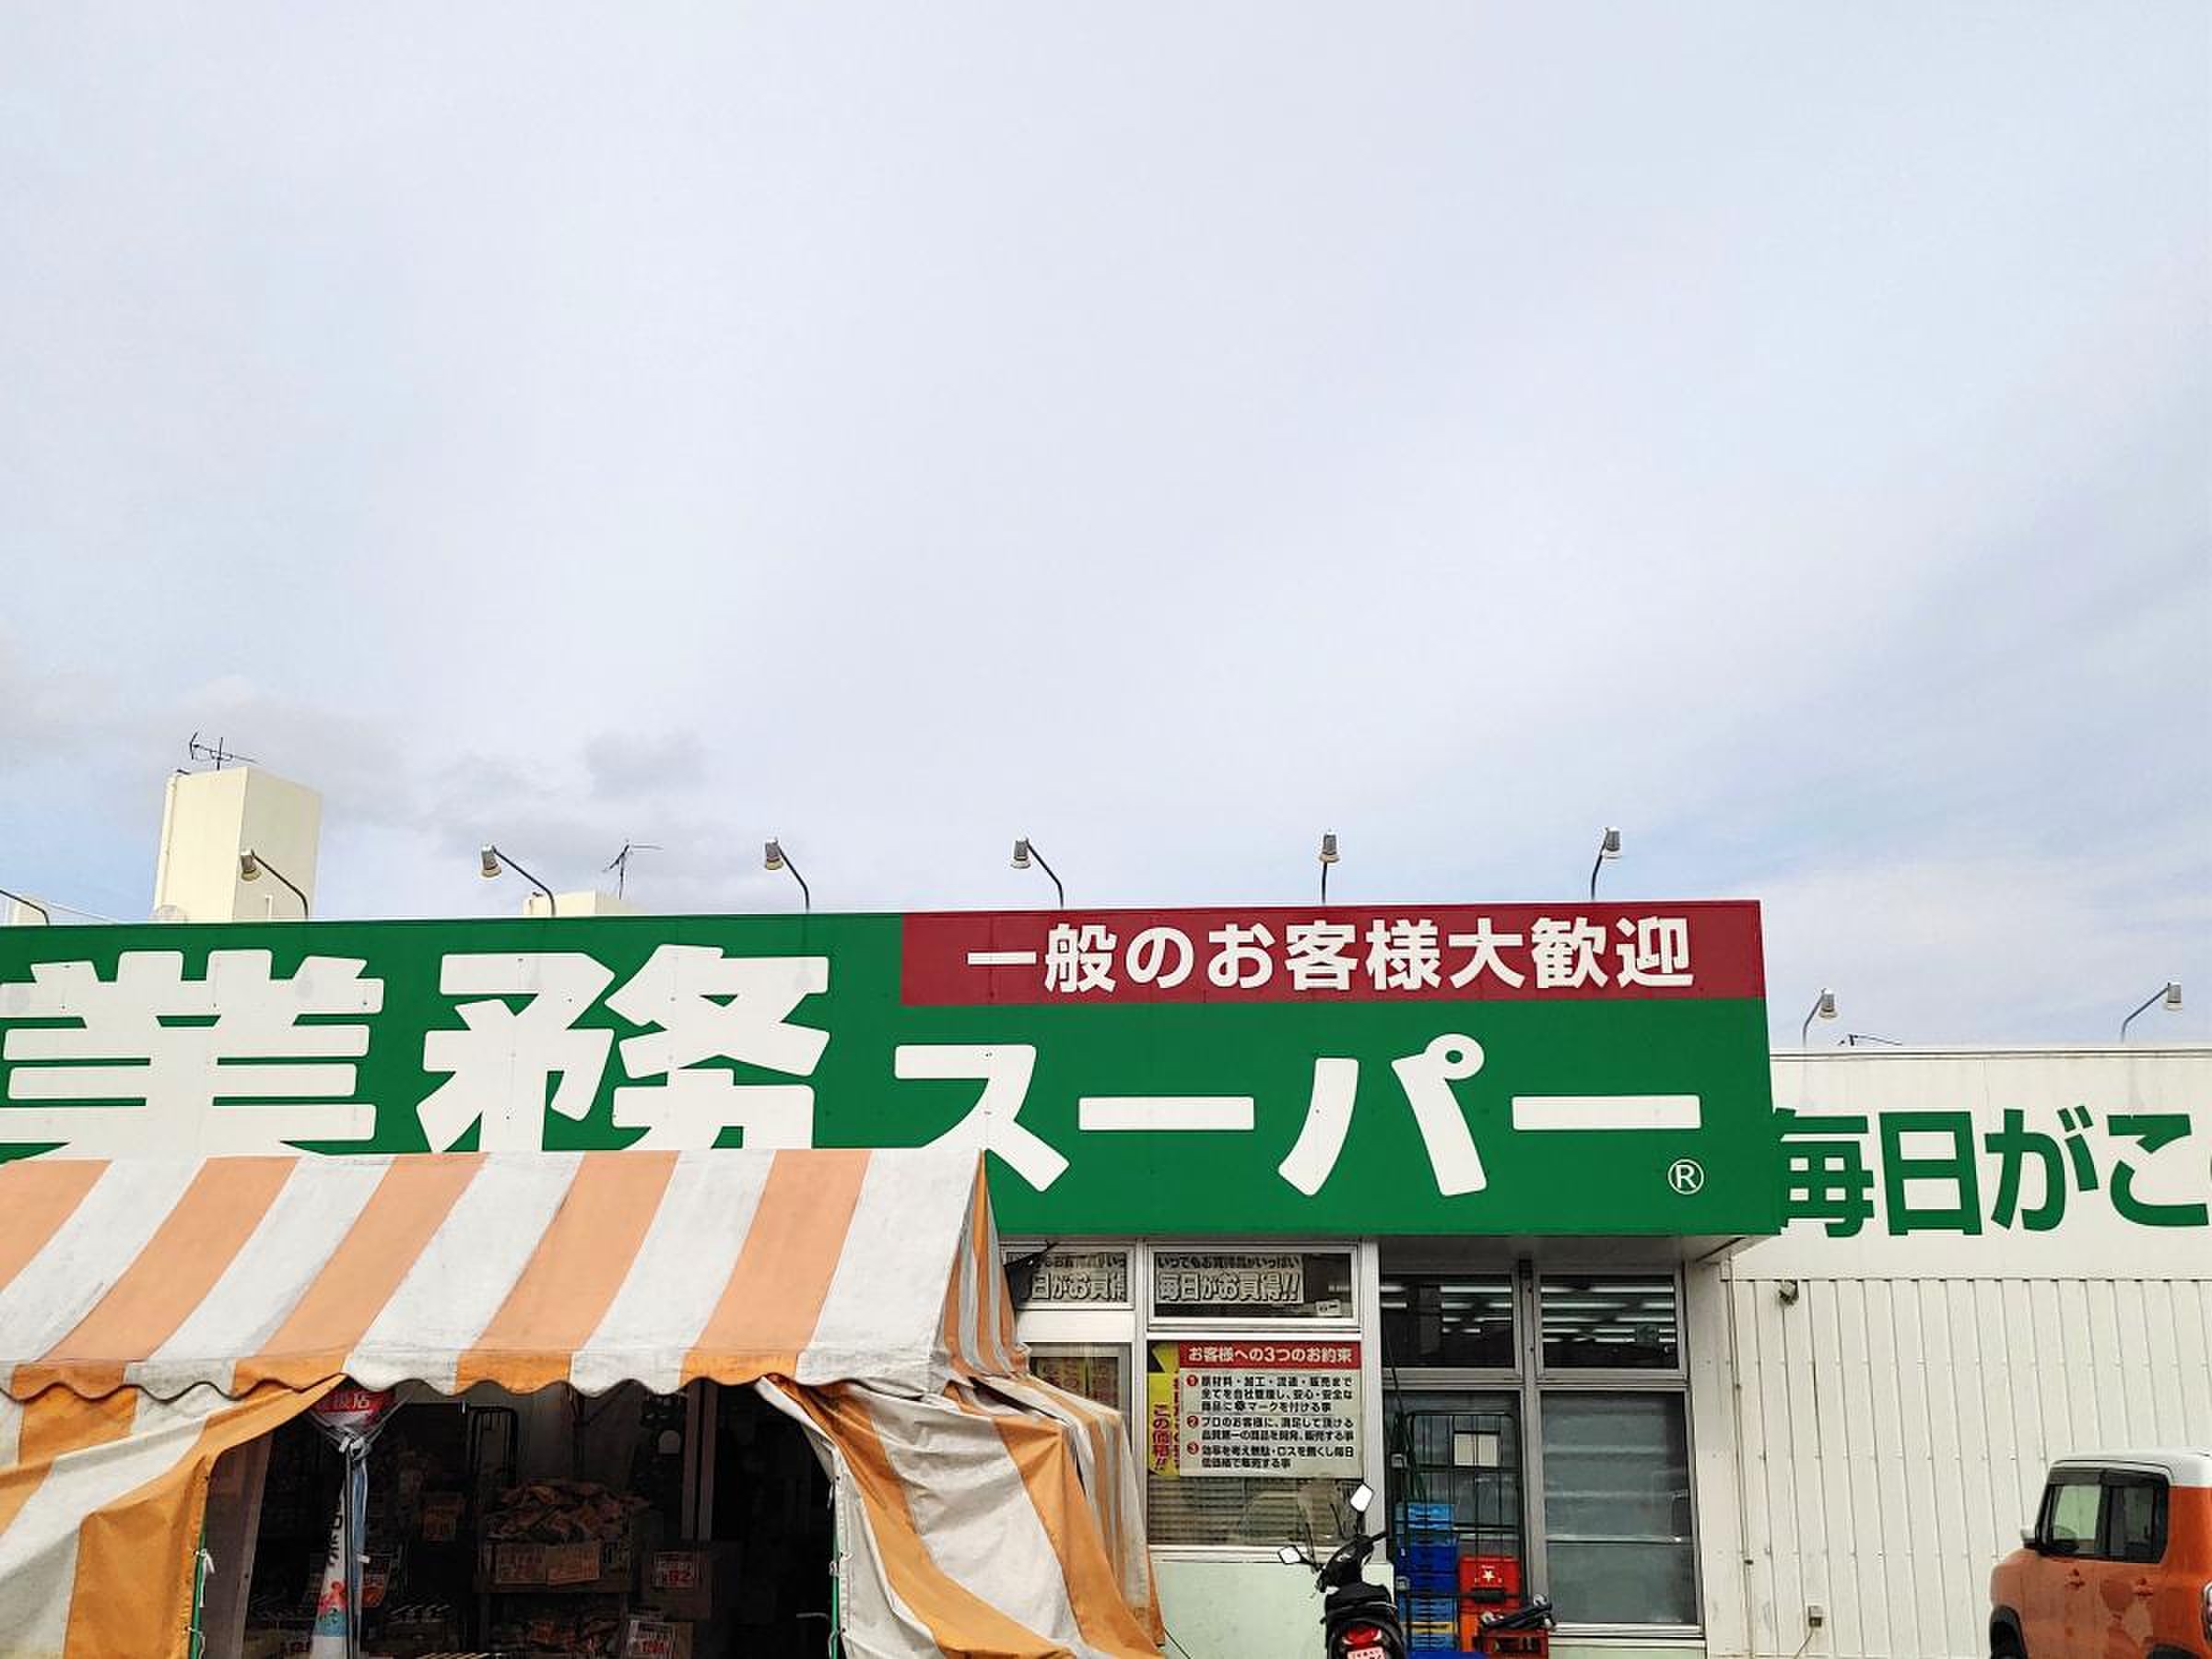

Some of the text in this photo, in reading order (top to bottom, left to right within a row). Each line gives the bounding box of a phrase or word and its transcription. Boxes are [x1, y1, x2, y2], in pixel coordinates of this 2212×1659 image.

[967, 915, 1694, 993] 一般のお客様大歓迎
[1773, 1104, 2212, 1238] 毎日がこ
[1188, 1346, 1353, 1364] お客様への3つのお約束
